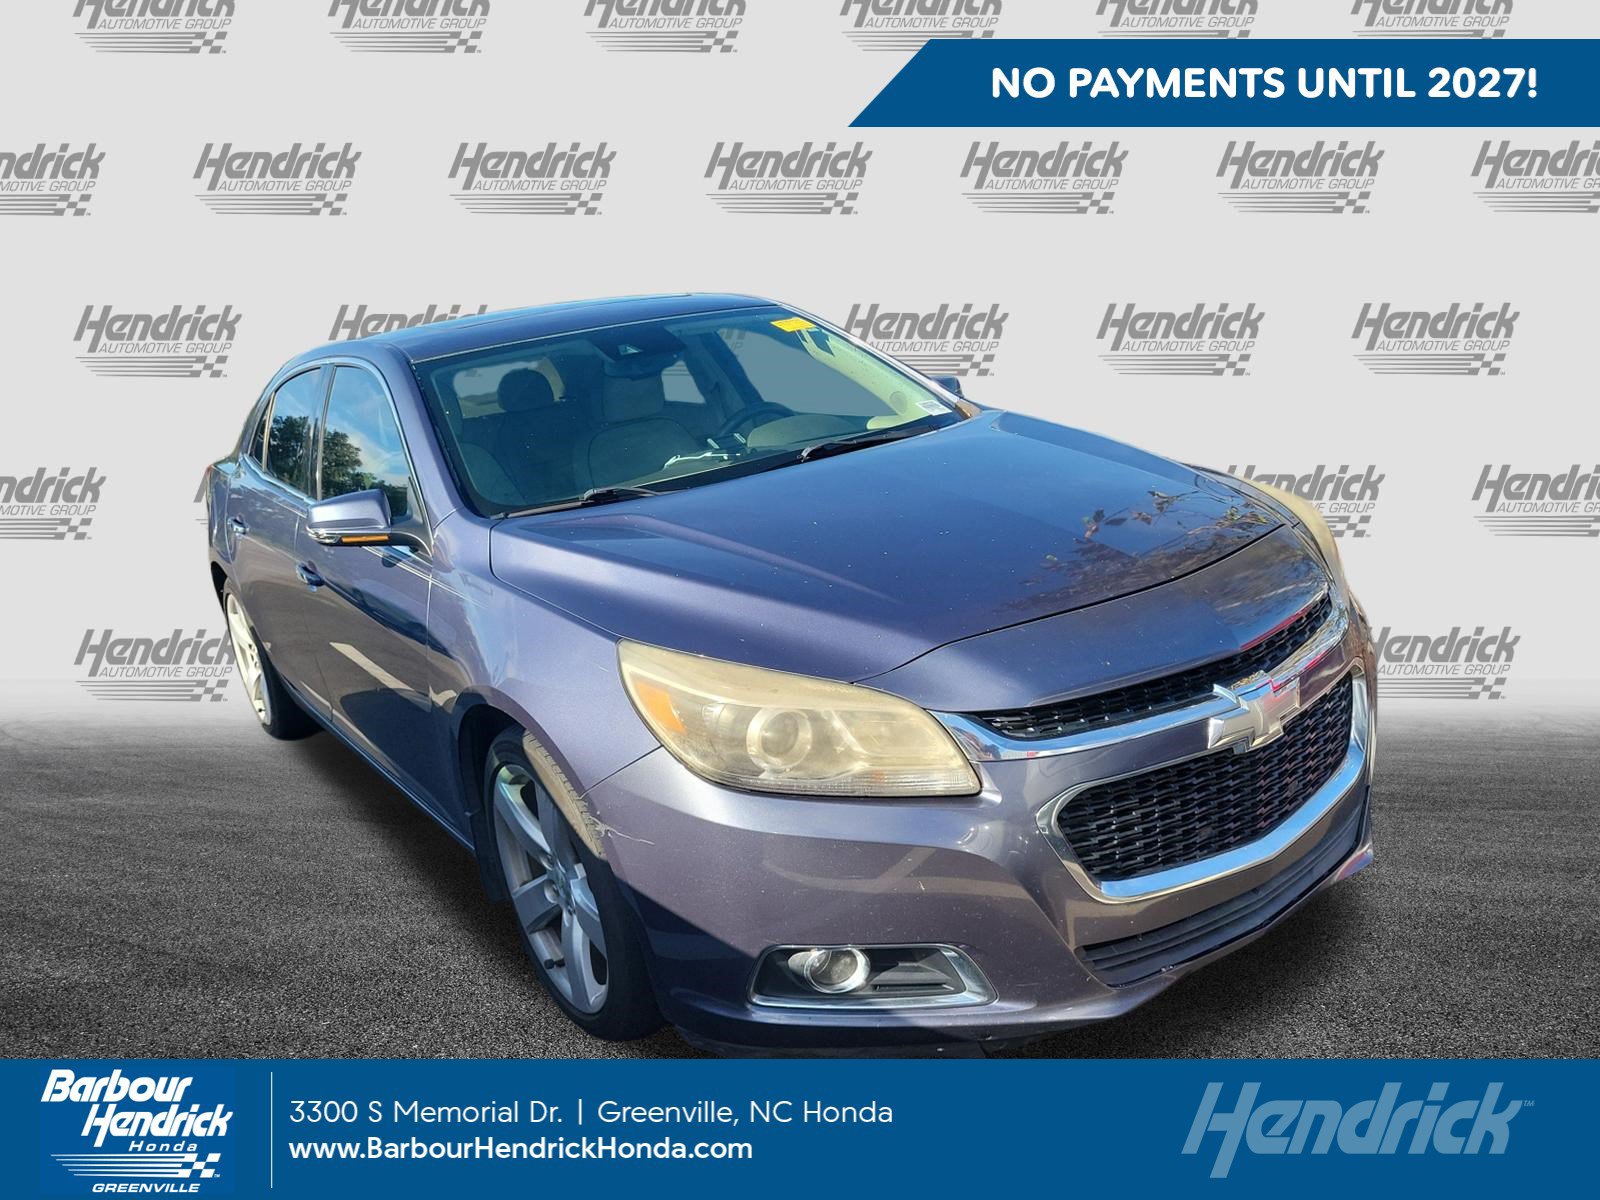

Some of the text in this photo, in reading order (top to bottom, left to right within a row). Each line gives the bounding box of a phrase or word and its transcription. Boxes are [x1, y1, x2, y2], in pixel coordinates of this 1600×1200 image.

[98, 19, 231, 29] AUTOMOTIVE GROUP
[353, 18, 486, 29] AUTOMOTIVE GROUP
[609, 18, 742, 28] AUTOMOTIVE GROUP
[865, 17, 998, 28] AUTOMOTIVE GROUP
[1120, 17, 1254, 27] AUTOMOTIVE GROUP
[1376, 16, 1509, 27] AUTOMOTIVE GROUP
[193, 143, 362, 191] Hendrick
[448, 142, 617, 190] Hendrick
[704, 142, 873, 190] Hendrick
[960, 141, 1129, 189] Hendrick
[1215, 141, 1385, 189] Hendrick
[1471, 140, 1600, 188] Hendri
[49, 181, 96, 191] GROUP
[218, 180, 351, 191] AUTOMOTIVE GROUP
[473, 180, 606, 190] AUTOMOTIVE GROUP
[729, 179, 862, 190] AUTOMOTIVE GROUP
[985, 179, 1119, 190] AUTOMOTIVE GROUP
[1241, 178, 1375, 189] AUTOMOTIVE GROUP
[1496, 178, 1580, 188] AUTOMOTIVE
[845, 303, 1009, 342] Hendrick
[1096, 303, 1265, 351] Hendrick
[1351, 303, 1520, 351] Hendrick
[73, 305, 242, 353] Hendrick
[98, 343, 232, 353] AUTOMOTIVE GROUP
[952, 341, 999, 352] GROUP
[1121, 341, 1255, 351] AUTOMOTIVE GROUP
[1376, 340, 1510, 351] AUTOMOTIVE GROUP
[1472, 464, 1600, 512] Hendri
[49, 505, 96, 515] GROUP
[1329, 503, 1375, 513] GROUP
[1497, 502, 1581, 512] AUTOMOTIVE
[74, 629, 236, 677] Hendrick
[99, 667, 232, 677] AUTOMOTIVE GROUP
[1378, 664, 1510, 675] AUTOMOTIVE GROUP
